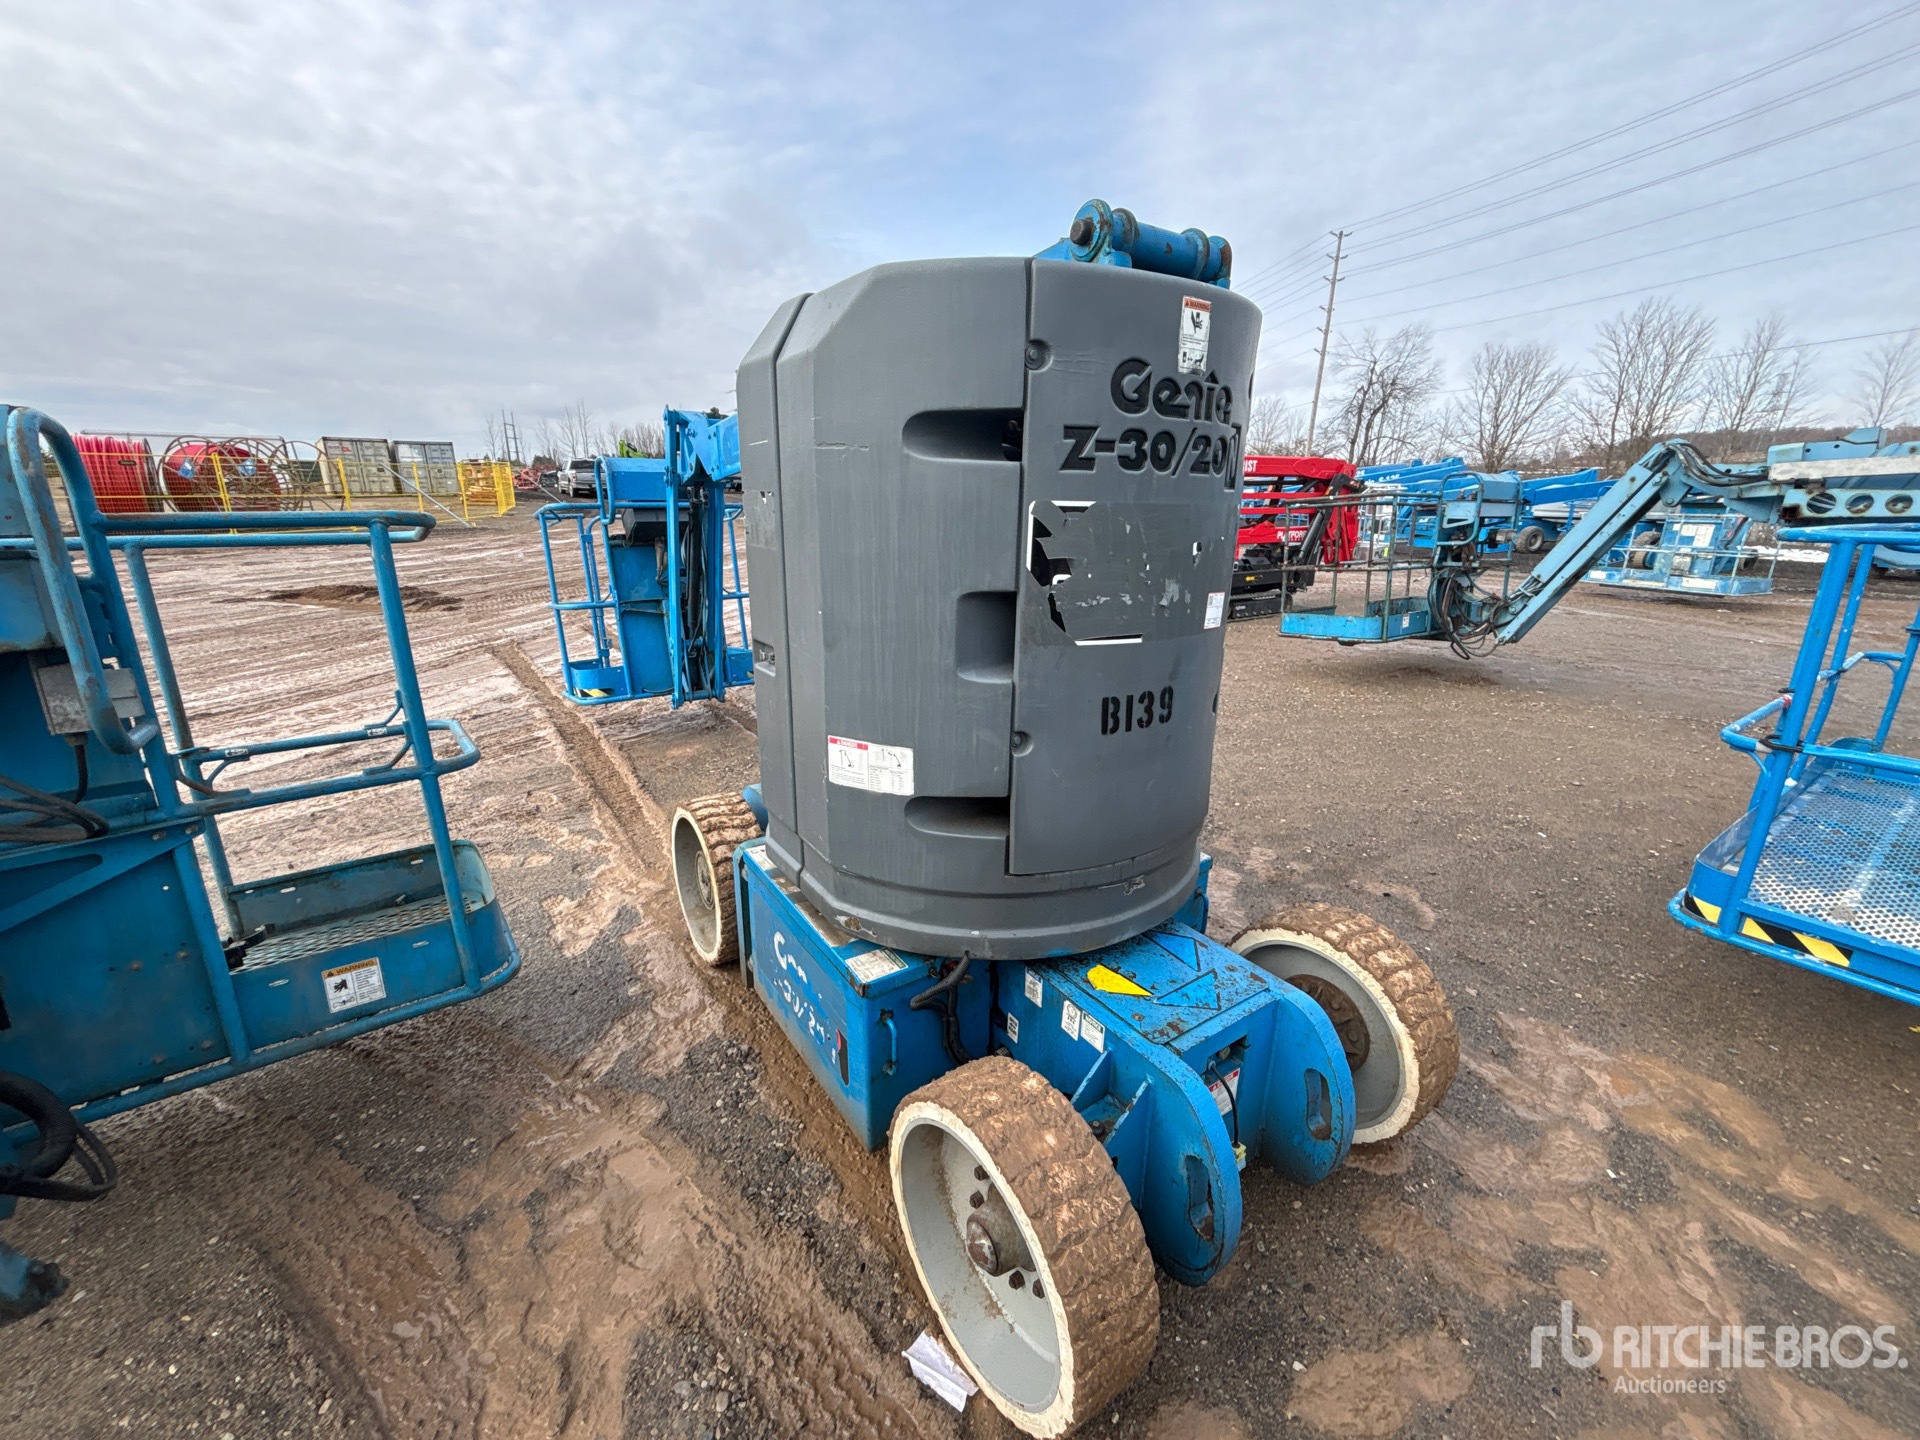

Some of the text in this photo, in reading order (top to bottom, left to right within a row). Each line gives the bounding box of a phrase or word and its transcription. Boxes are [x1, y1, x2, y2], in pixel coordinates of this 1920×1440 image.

[1111, 357, 1233, 425] Genie
[1243, 460, 1258, 472] IST
[1101, 686, 1174, 735] B139
[336, 960, 374, 975] WARNING
